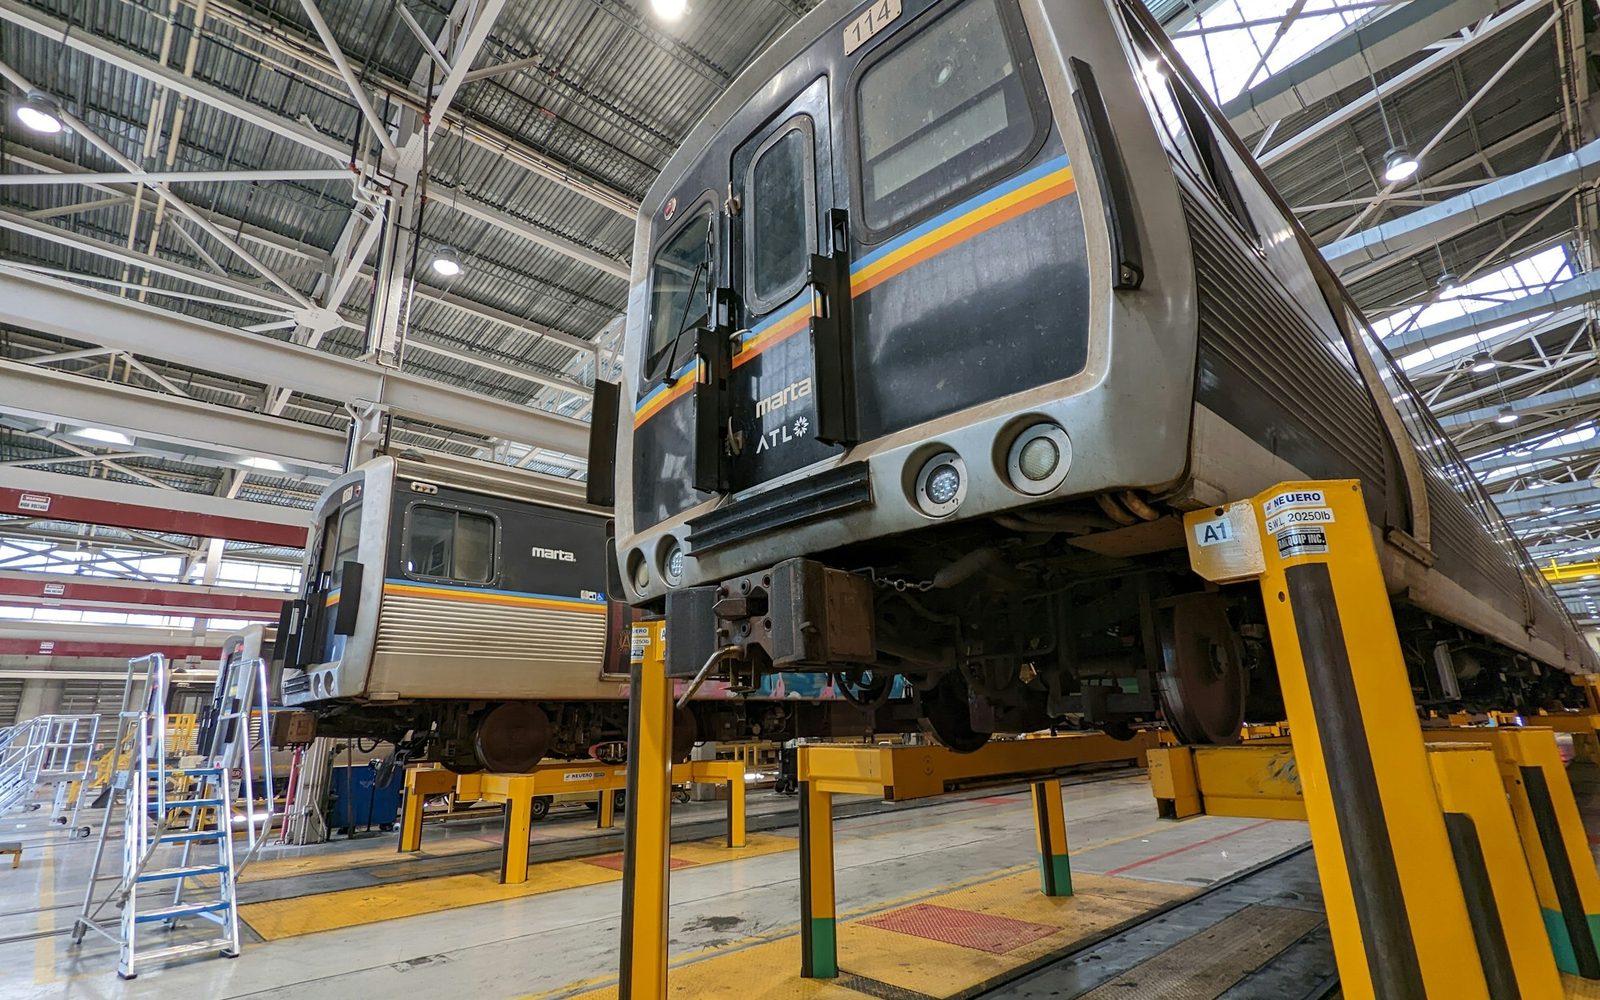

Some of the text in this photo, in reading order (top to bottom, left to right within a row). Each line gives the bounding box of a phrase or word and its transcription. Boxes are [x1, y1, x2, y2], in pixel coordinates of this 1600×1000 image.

[852, 0, 891, 41] 114
[756, 377, 812, 419] marta
[756, 425, 793, 454] ATL
[1273, 492, 1321, 508] NEUERO
[1288, 511, 1331, 523] 20250lb
[1203, 522, 1227, 543] A1
[532, 547, 575, 562] marta
